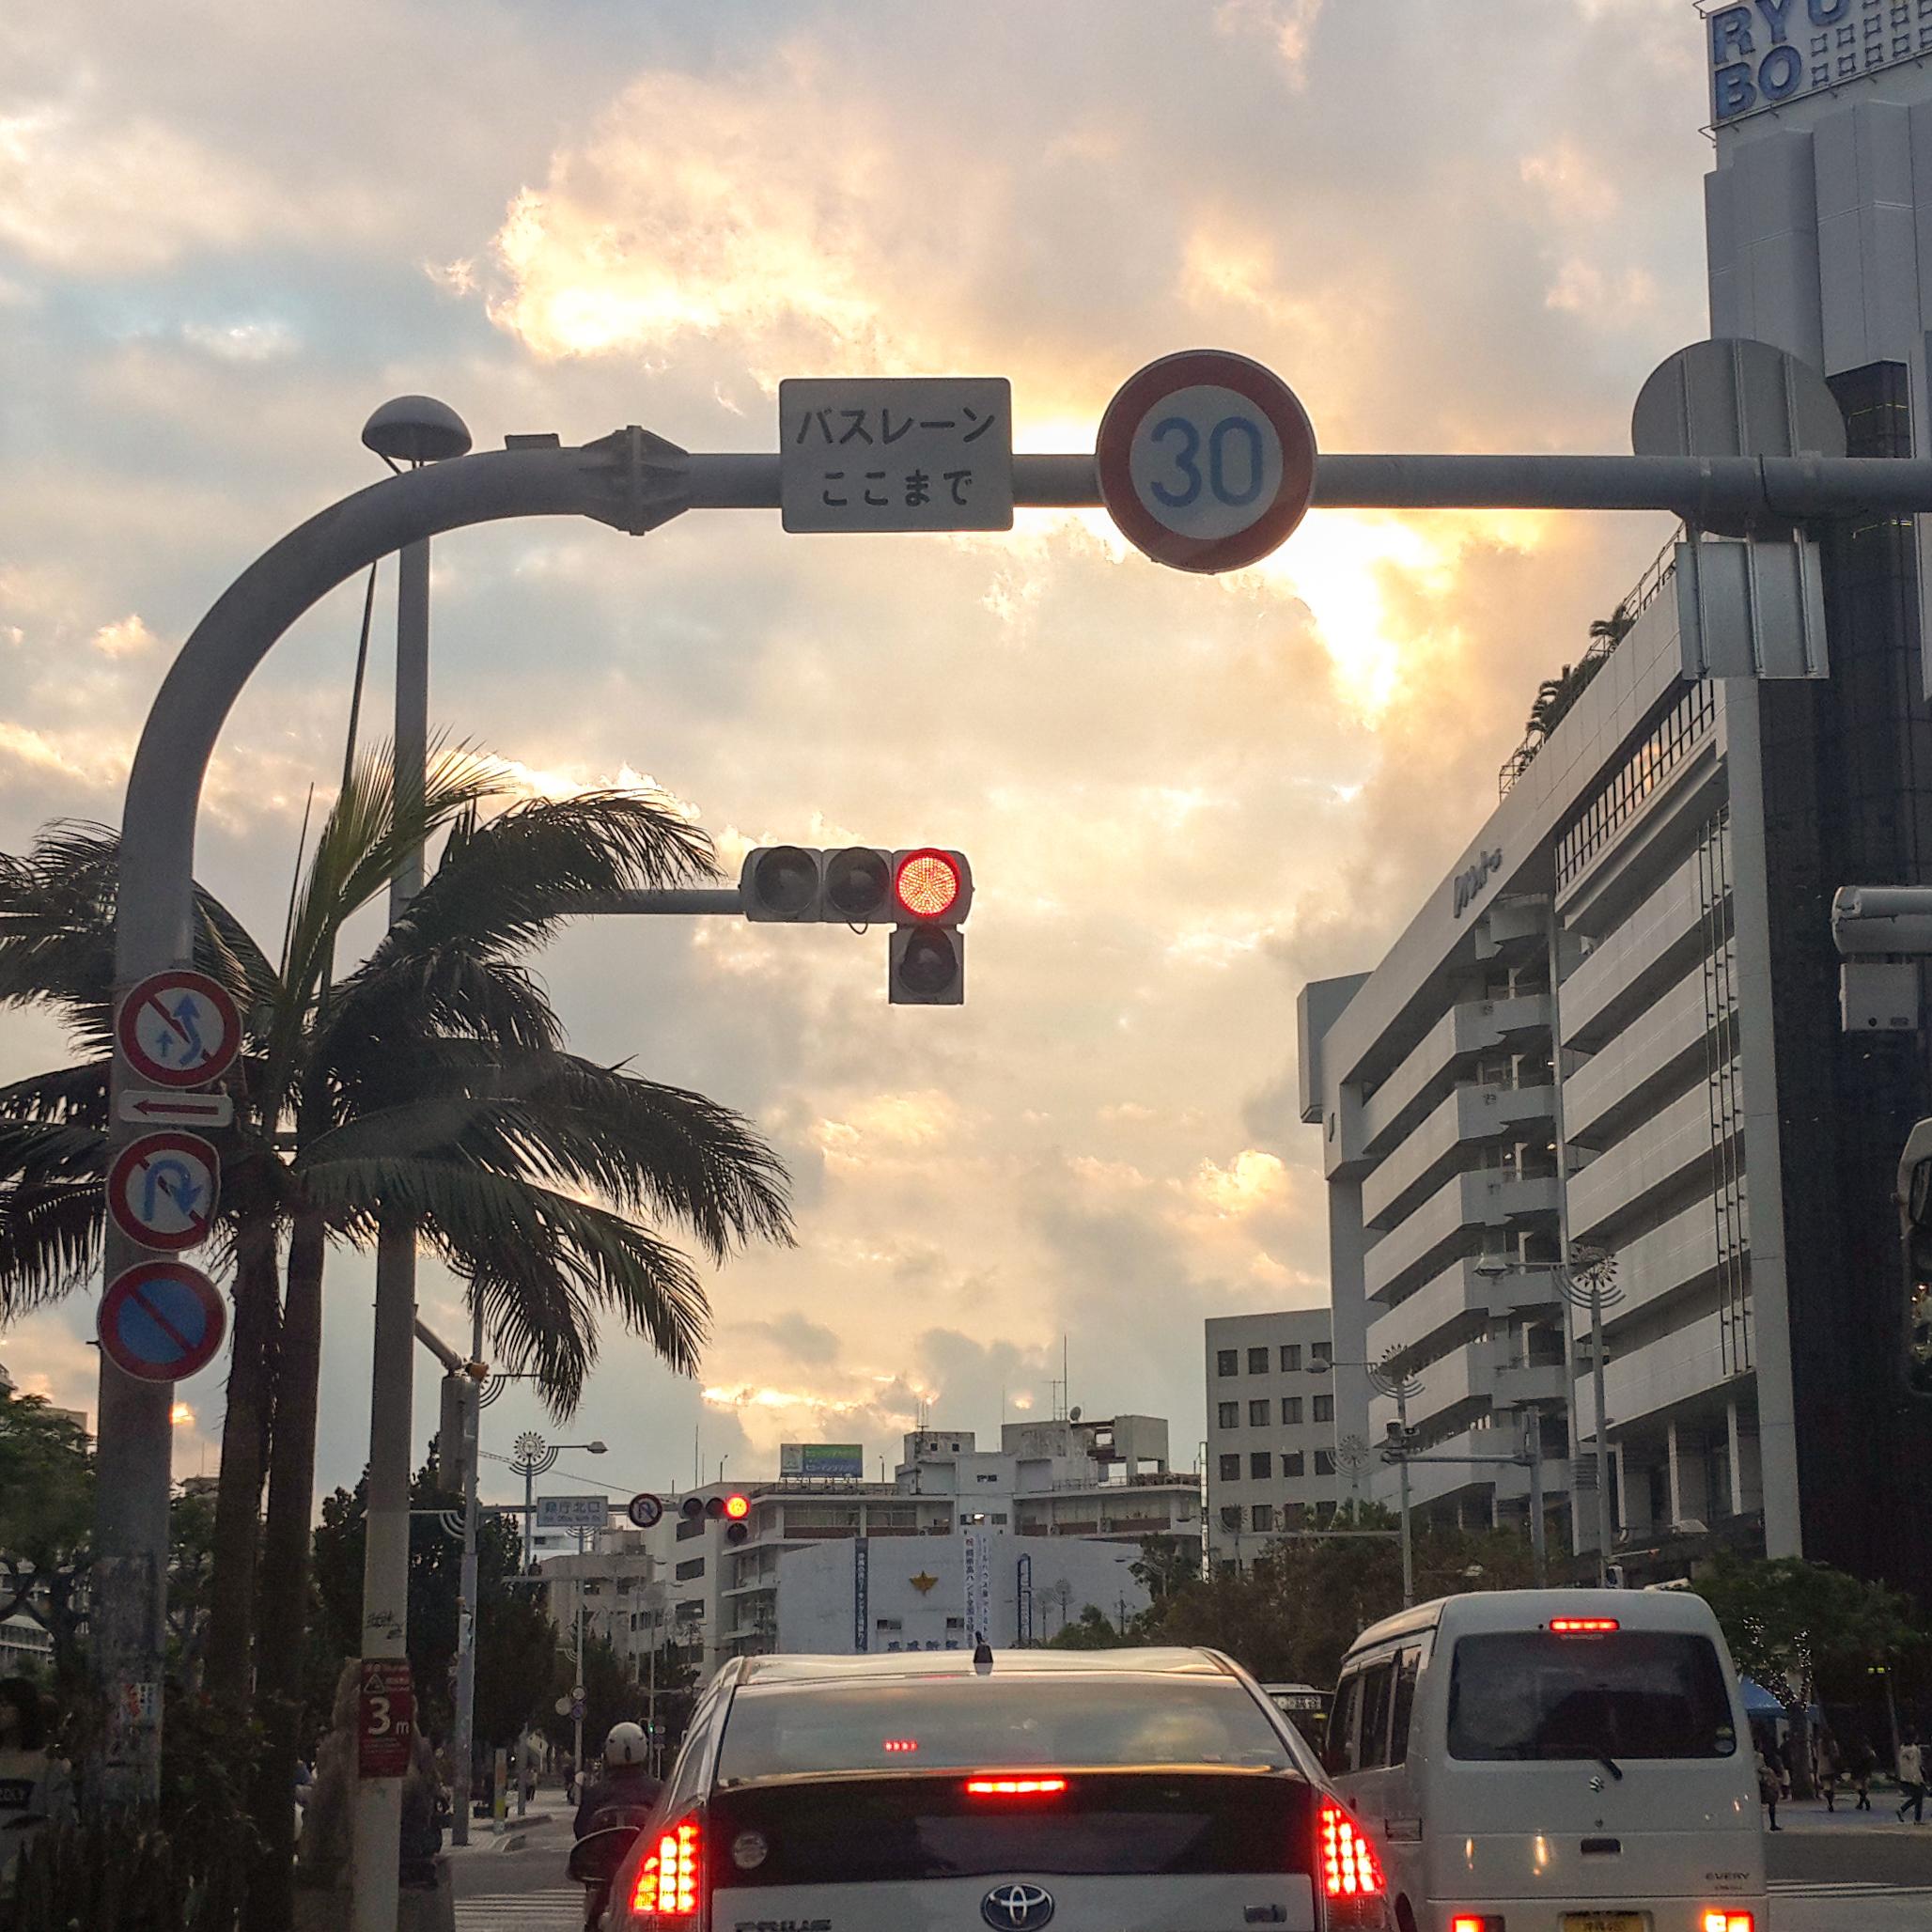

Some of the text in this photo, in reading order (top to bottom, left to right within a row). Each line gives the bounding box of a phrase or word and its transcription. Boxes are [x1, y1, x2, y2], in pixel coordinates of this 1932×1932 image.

[1715, 45, 1802, 120] BO
[796, 406, 995, 444] バスレーン
[821, 469, 974, 506] ここまで
[1149, 415, 1264, 508] 30
